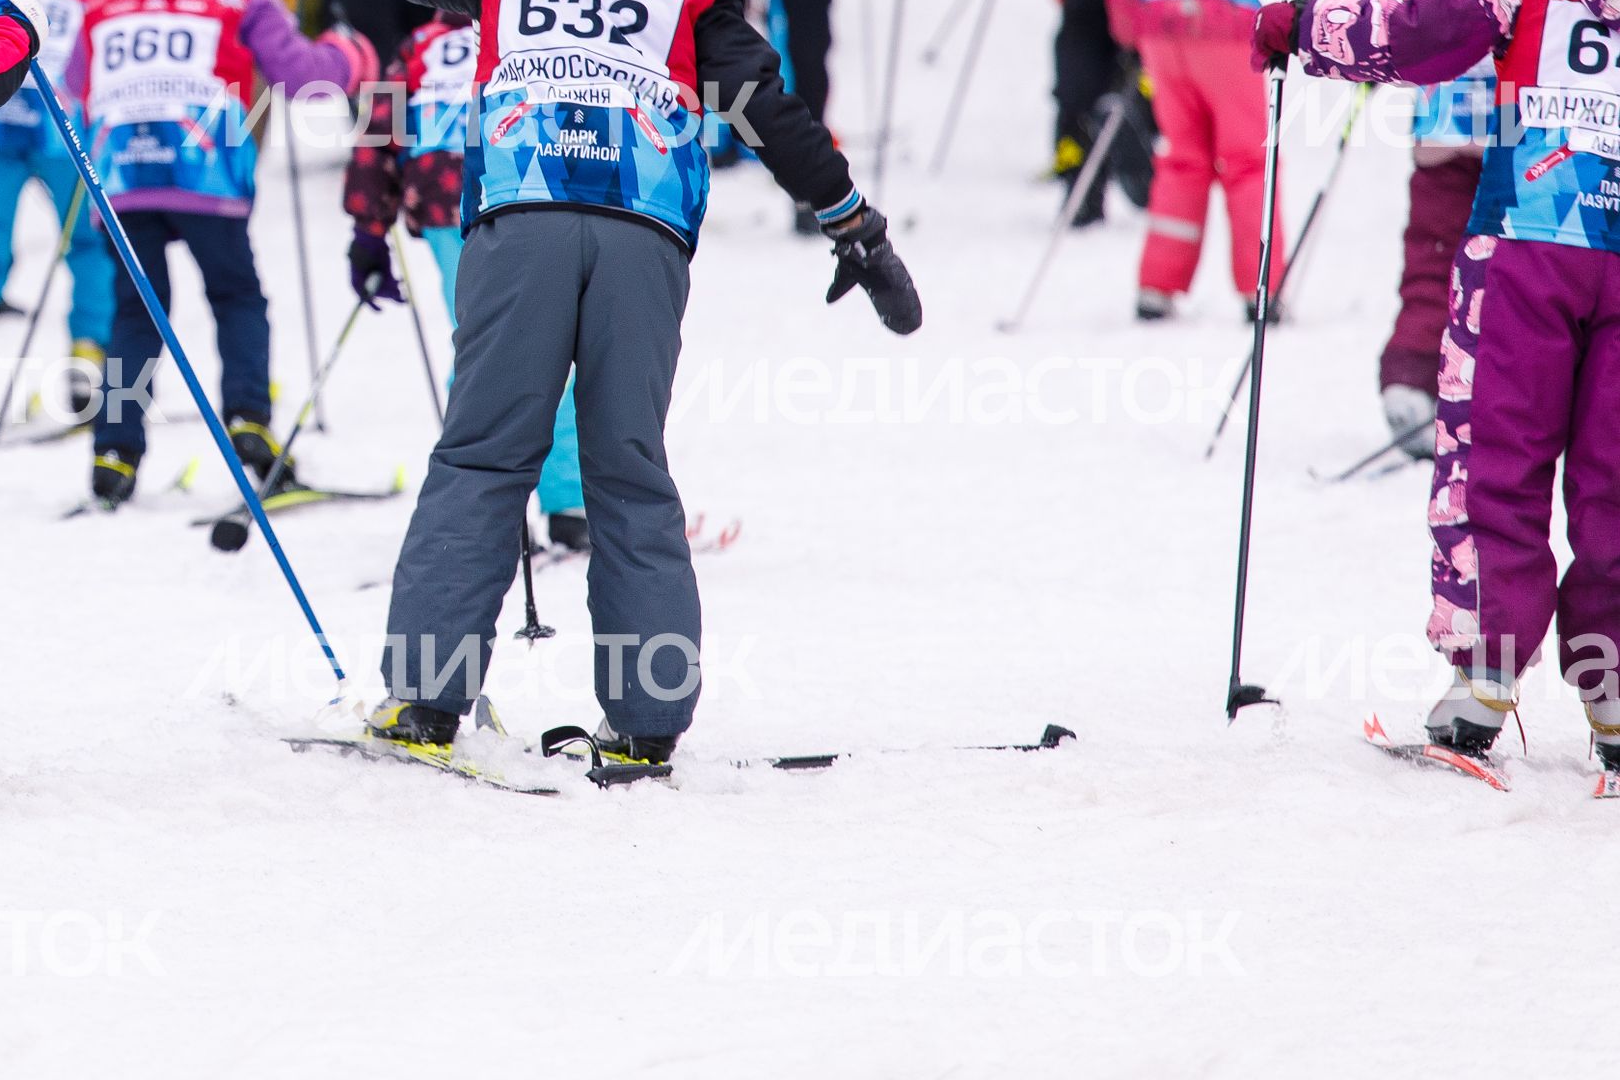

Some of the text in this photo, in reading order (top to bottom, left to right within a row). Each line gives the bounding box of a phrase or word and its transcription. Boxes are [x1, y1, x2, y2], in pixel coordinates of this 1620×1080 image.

[103, 28, 193, 70] 660
[1568, 19, 1620, 74] 6
[547, 86, 611, 104] ЛЫЖНЯ
[1526, 94, 1620, 129] МАНЖО
[559, 129, 598, 145] ПАРК
[535, 142, 621, 162] ЛАЗУТИНОЙ
